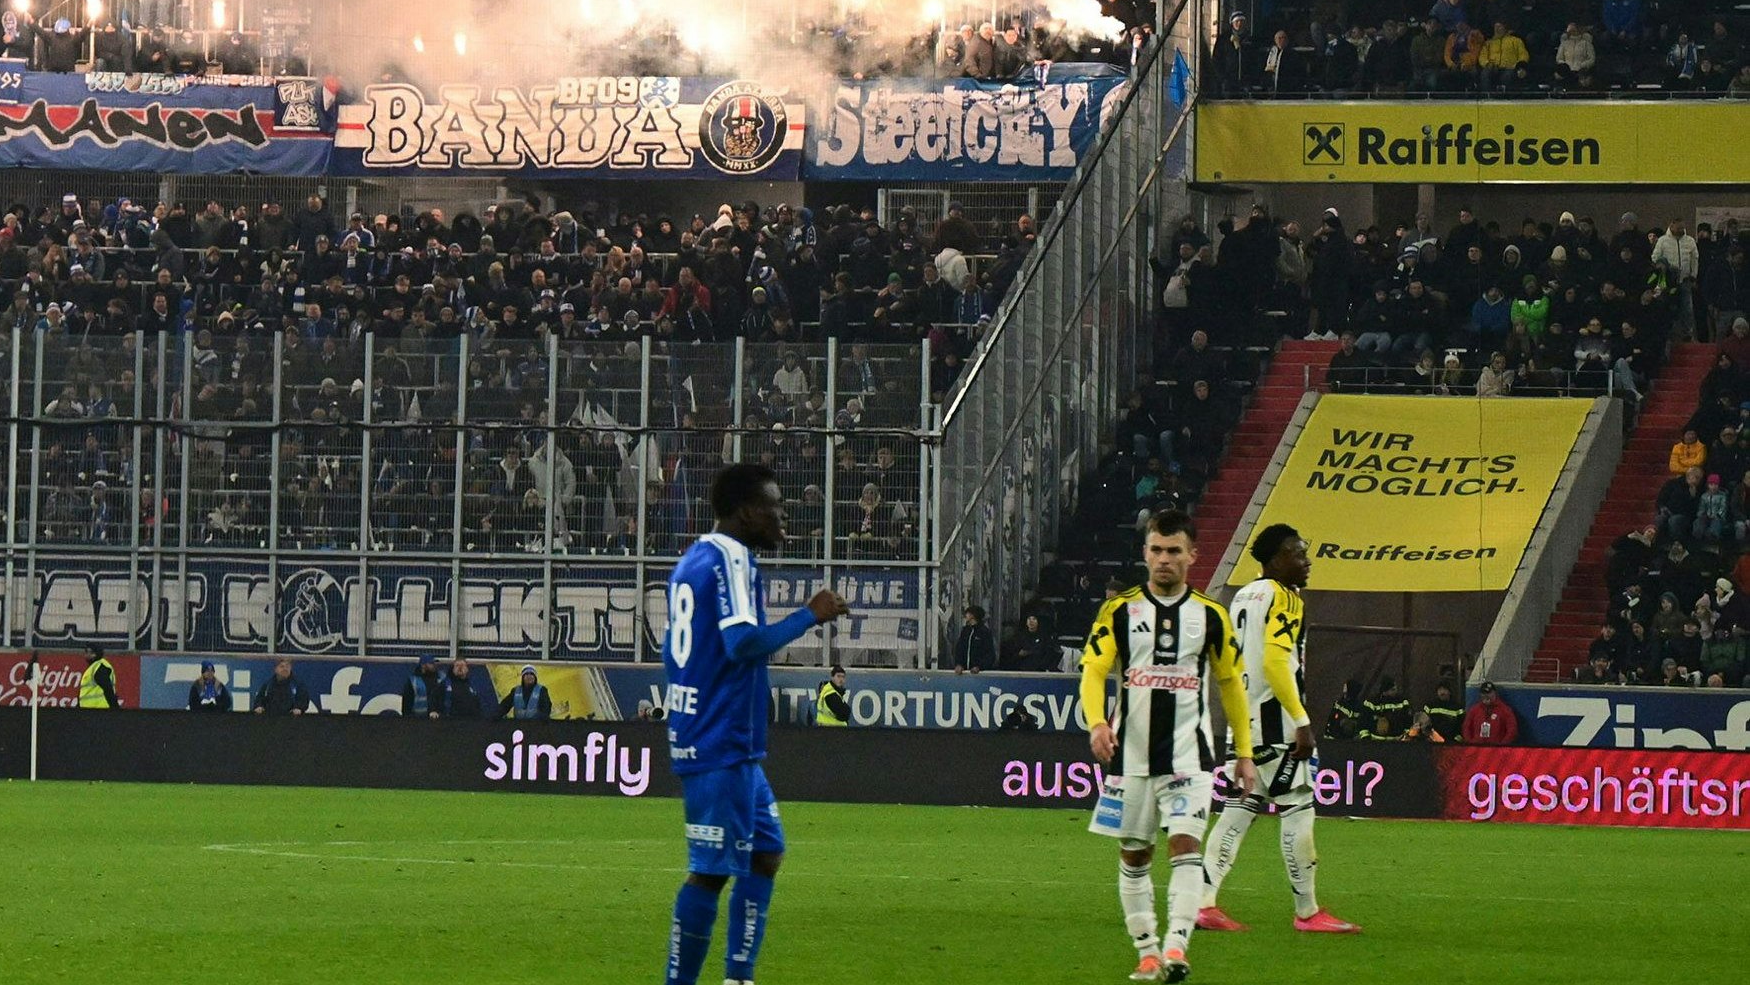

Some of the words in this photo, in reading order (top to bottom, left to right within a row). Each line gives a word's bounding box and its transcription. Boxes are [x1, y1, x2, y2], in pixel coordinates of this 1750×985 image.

[361, 82, 695, 169] BANDA
[1357, 123, 1600, 166] Raiffeisen
[1332, 428, 1415, 452] WIR
[1316, 449, 1517, 475] MACHT'S
[1305, 470, 1526, 497] MÖGLICH.
[1315, 543, 1498, 562] Raiffeisen
[484, 729, 651, 797] simfly
